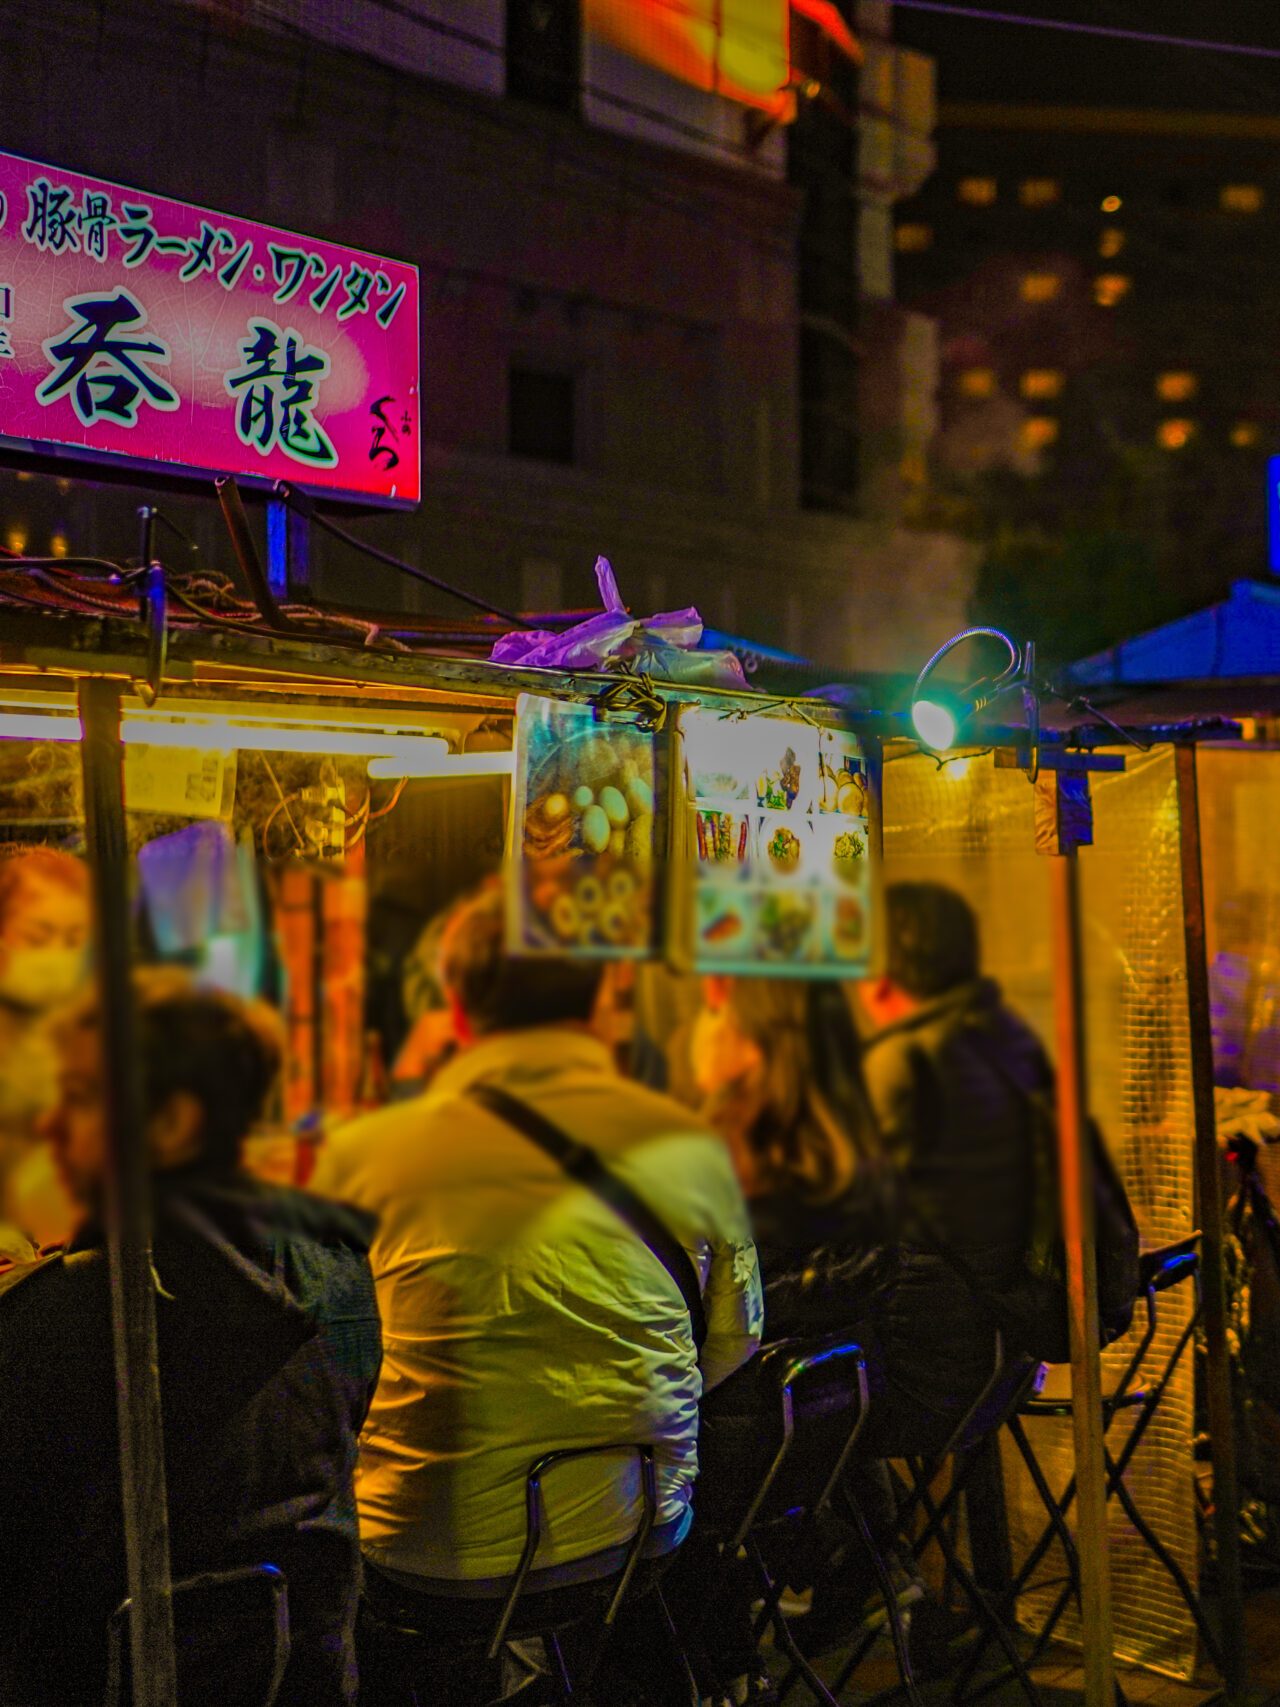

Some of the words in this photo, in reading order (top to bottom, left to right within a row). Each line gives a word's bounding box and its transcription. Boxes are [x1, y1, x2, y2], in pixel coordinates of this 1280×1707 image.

[27, 183, 404, 325] 豚骨ラーメン・ワンタン
[41, 294, 335, 462] 呑龍
